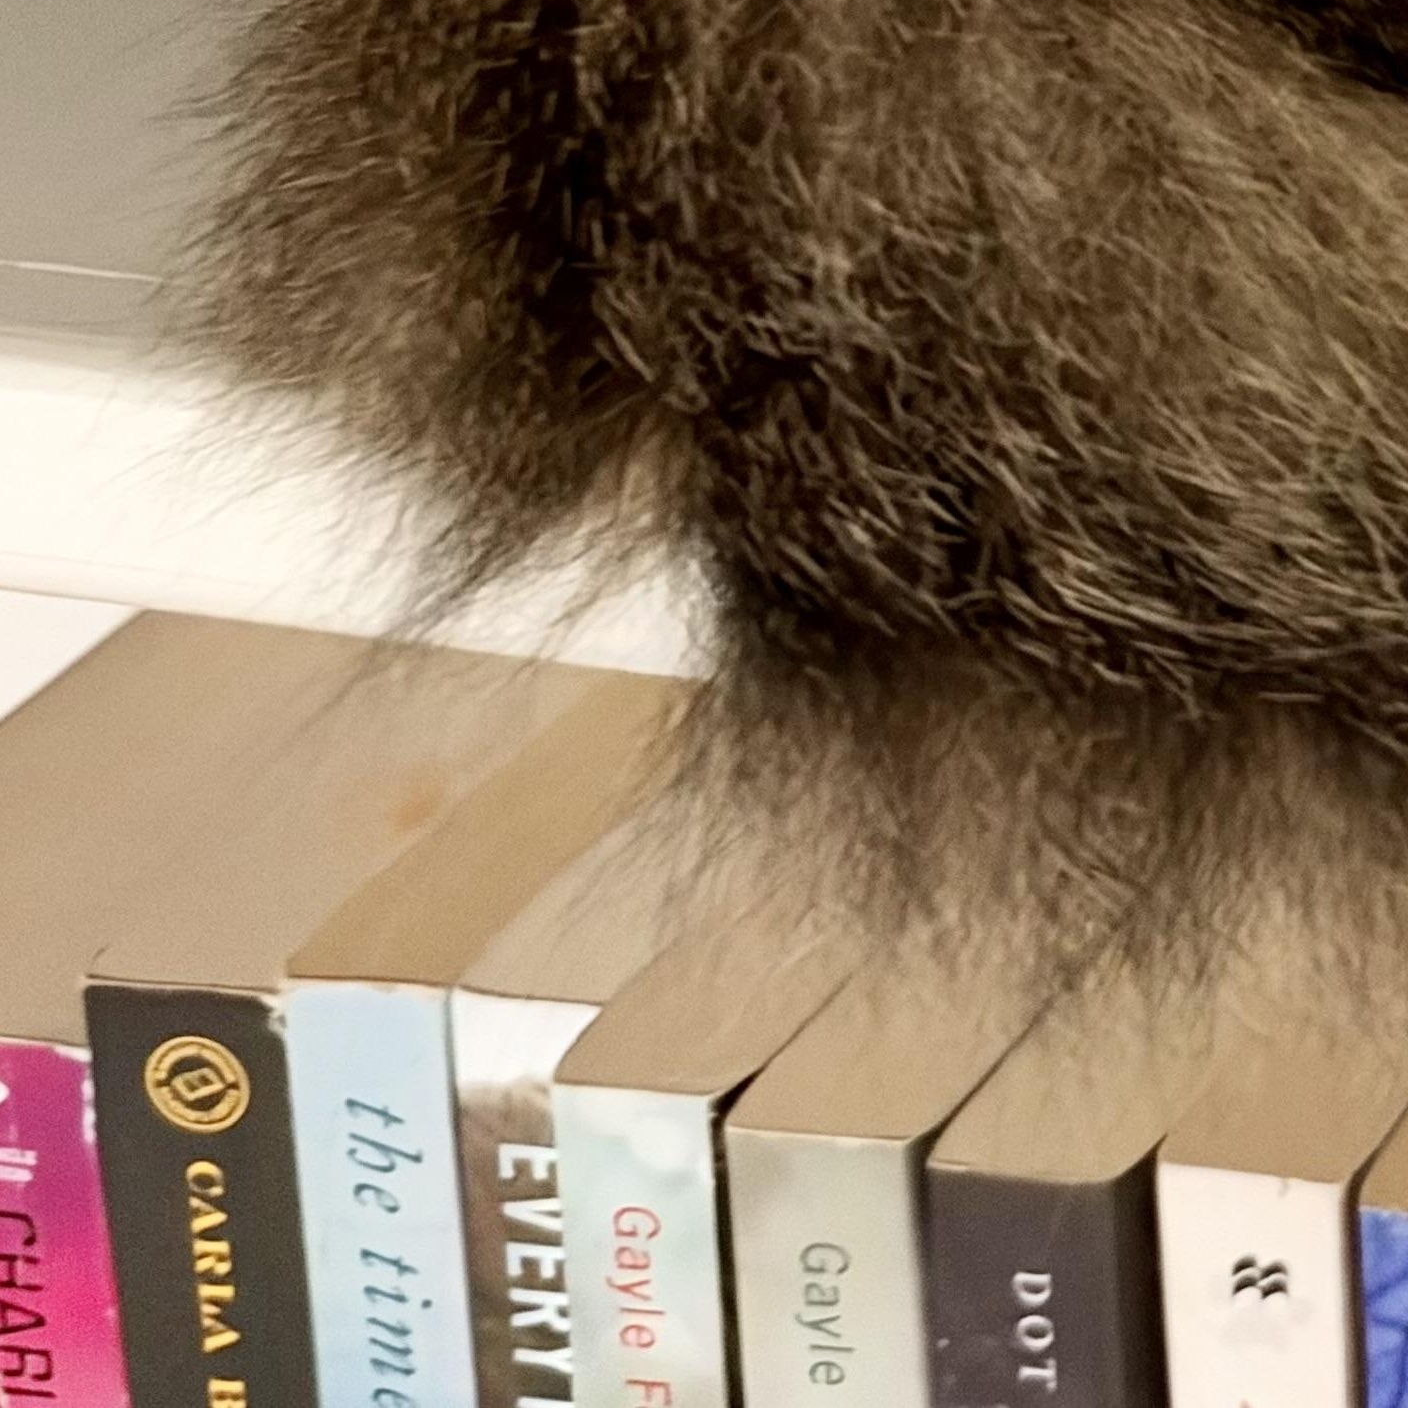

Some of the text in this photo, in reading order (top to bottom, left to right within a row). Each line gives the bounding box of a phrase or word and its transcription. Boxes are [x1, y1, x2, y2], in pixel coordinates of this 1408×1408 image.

[345, 1097, 423, 1213] the
[185, 1160, 240, 1354] CARLA
[498, 1142, 573, 1375] EVERY
[605, 1206, 665, 1350] Gayle
[795, 1241, 854, 1386] Gayle
[1012, 1271, 1057, 1393] DOT
